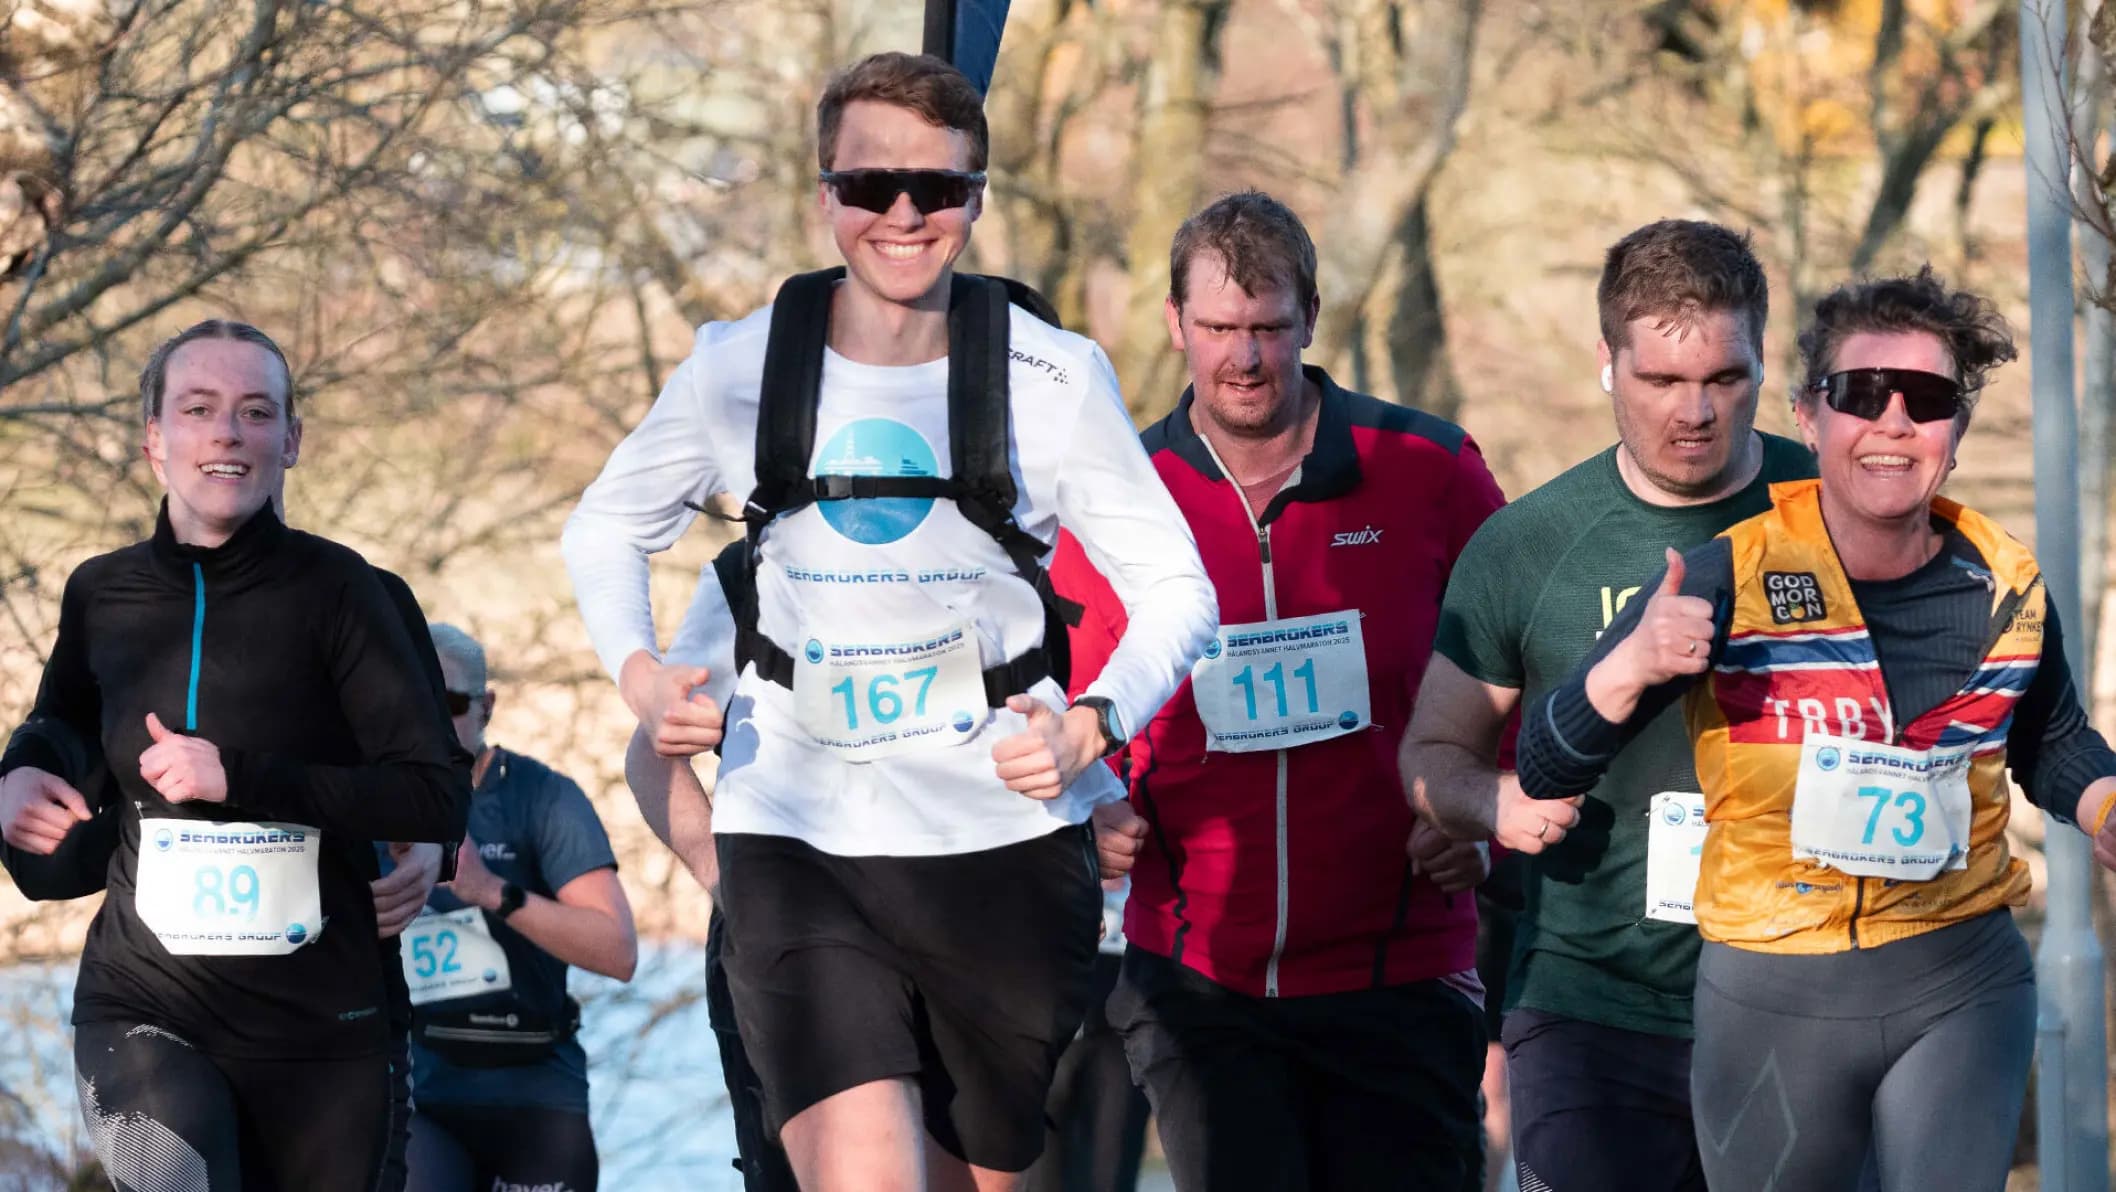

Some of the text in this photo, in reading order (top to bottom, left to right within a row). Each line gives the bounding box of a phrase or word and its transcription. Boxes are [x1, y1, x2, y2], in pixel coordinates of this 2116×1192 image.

[785, 566, 987, 584] SEABROKERS GROUP
[1768, 575, 1814, 590] GOD
[1771, 588, 1819, 607] MOR
[830, 628, 963, 657] SEABROKERS
[1227, 620, 1349, 648] SEABROKERS
[831, 665, 938, 730] 167
[1232, 658, 1319, 720] 111
[1293, 721, 1335, 733] GROUP
[1858, 786, 1927, 847] 73
[178, 829, 306, 845] SEABROKERS
[1900, 855, 1945, 866] GROUP
[193, 864, 260, 922] 89
[1658, 900, 1695, 911] SEAB
[412, 929, 462, 979] 52
